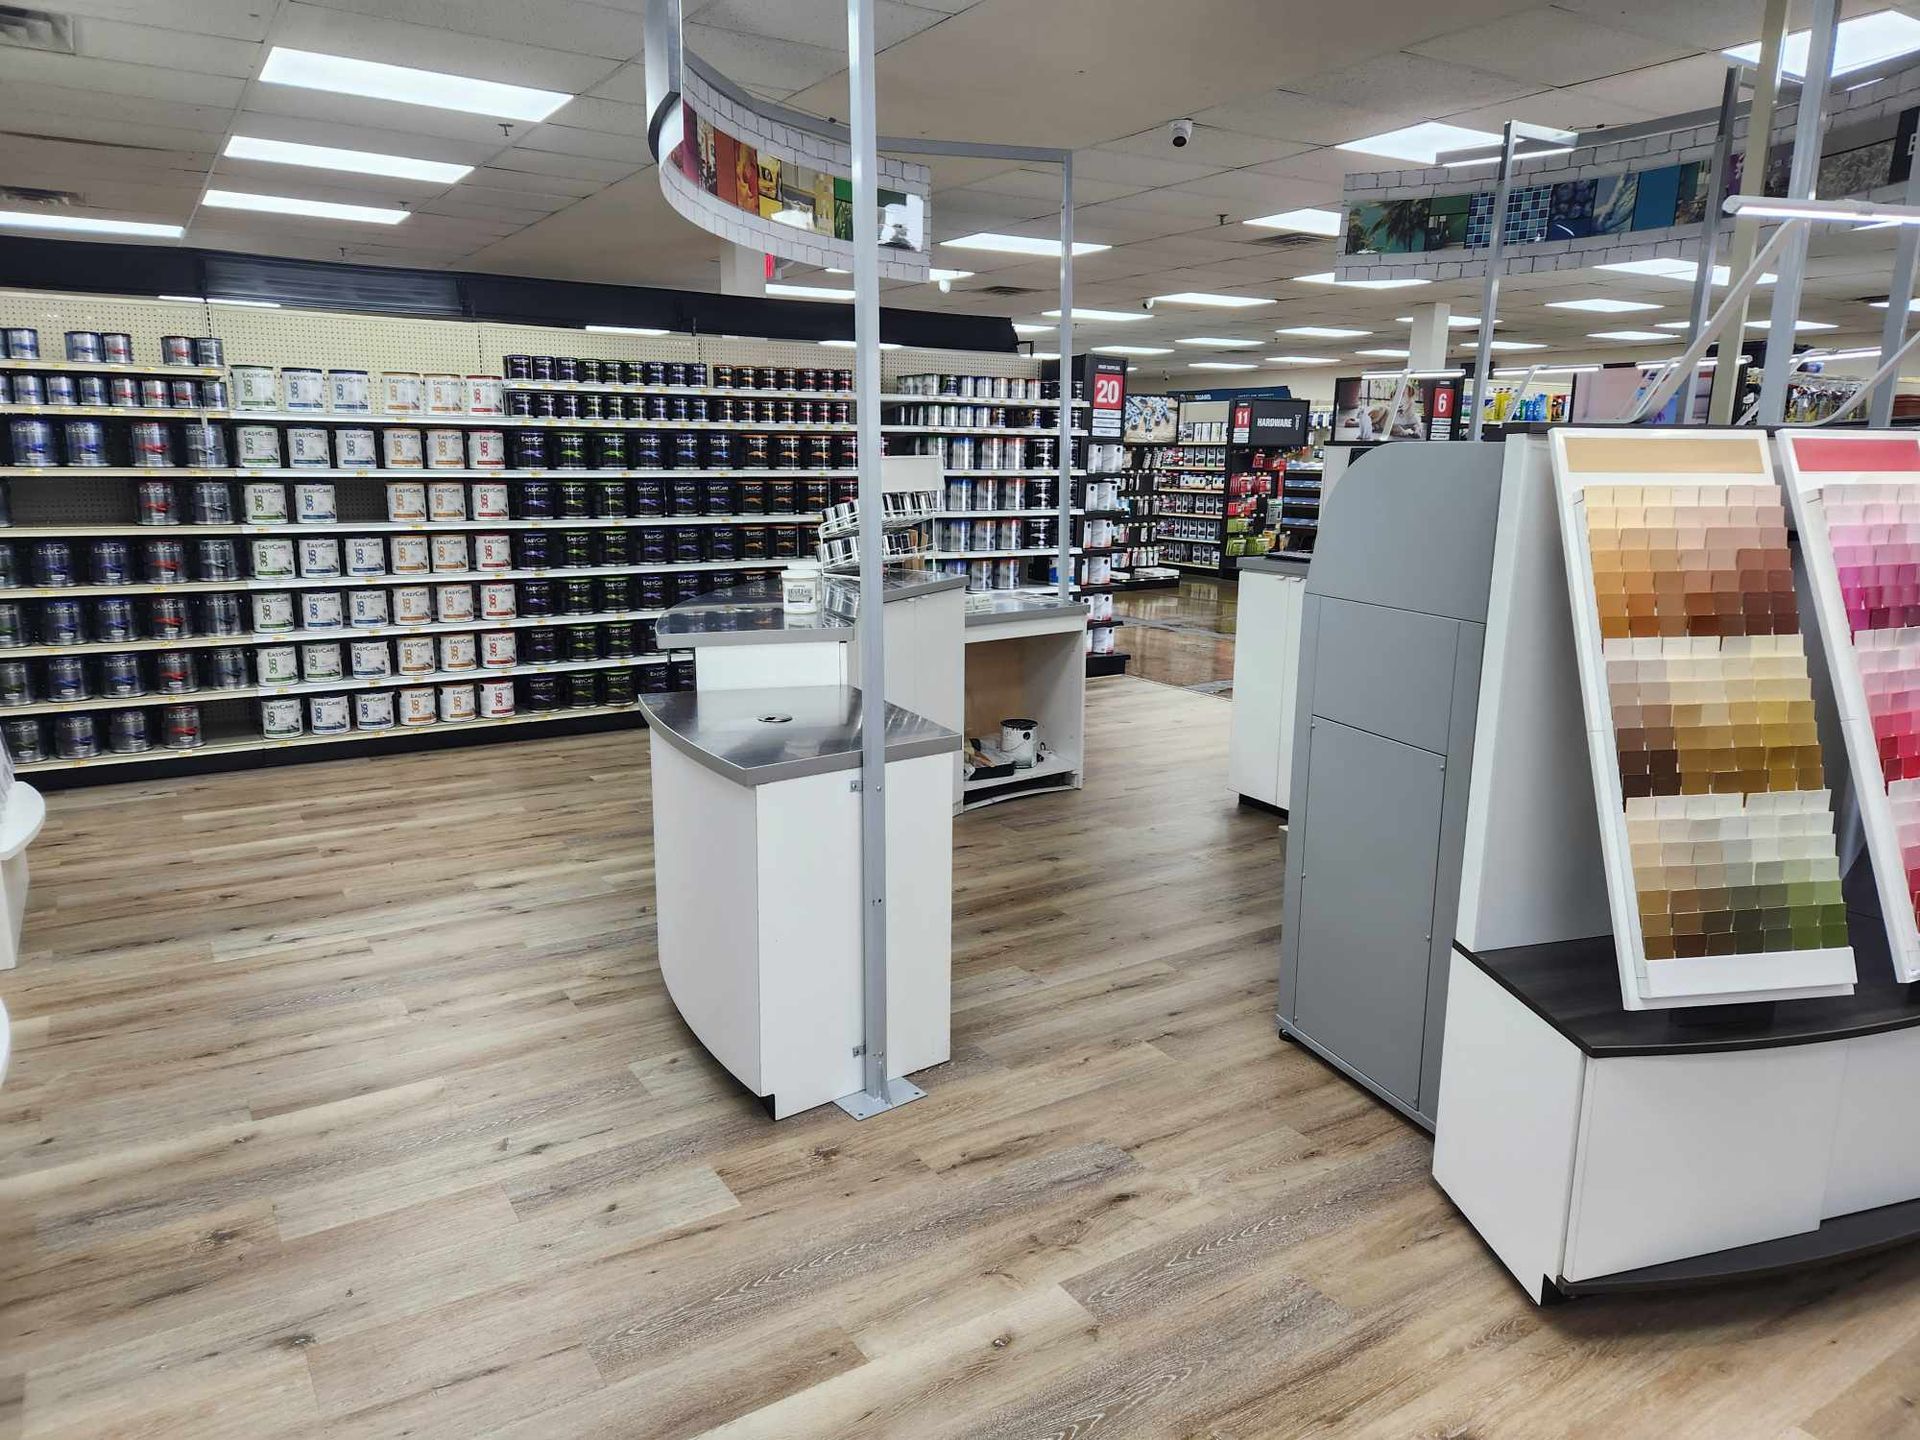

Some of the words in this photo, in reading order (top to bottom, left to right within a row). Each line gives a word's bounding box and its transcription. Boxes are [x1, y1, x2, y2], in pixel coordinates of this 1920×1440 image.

[1097, 379, 1119, 404] 20
[1438, 393, 1447, 412] 6
[1237, 411, 1248, 424] 11
[1257, 418, 1292, 427] HARDWARE
